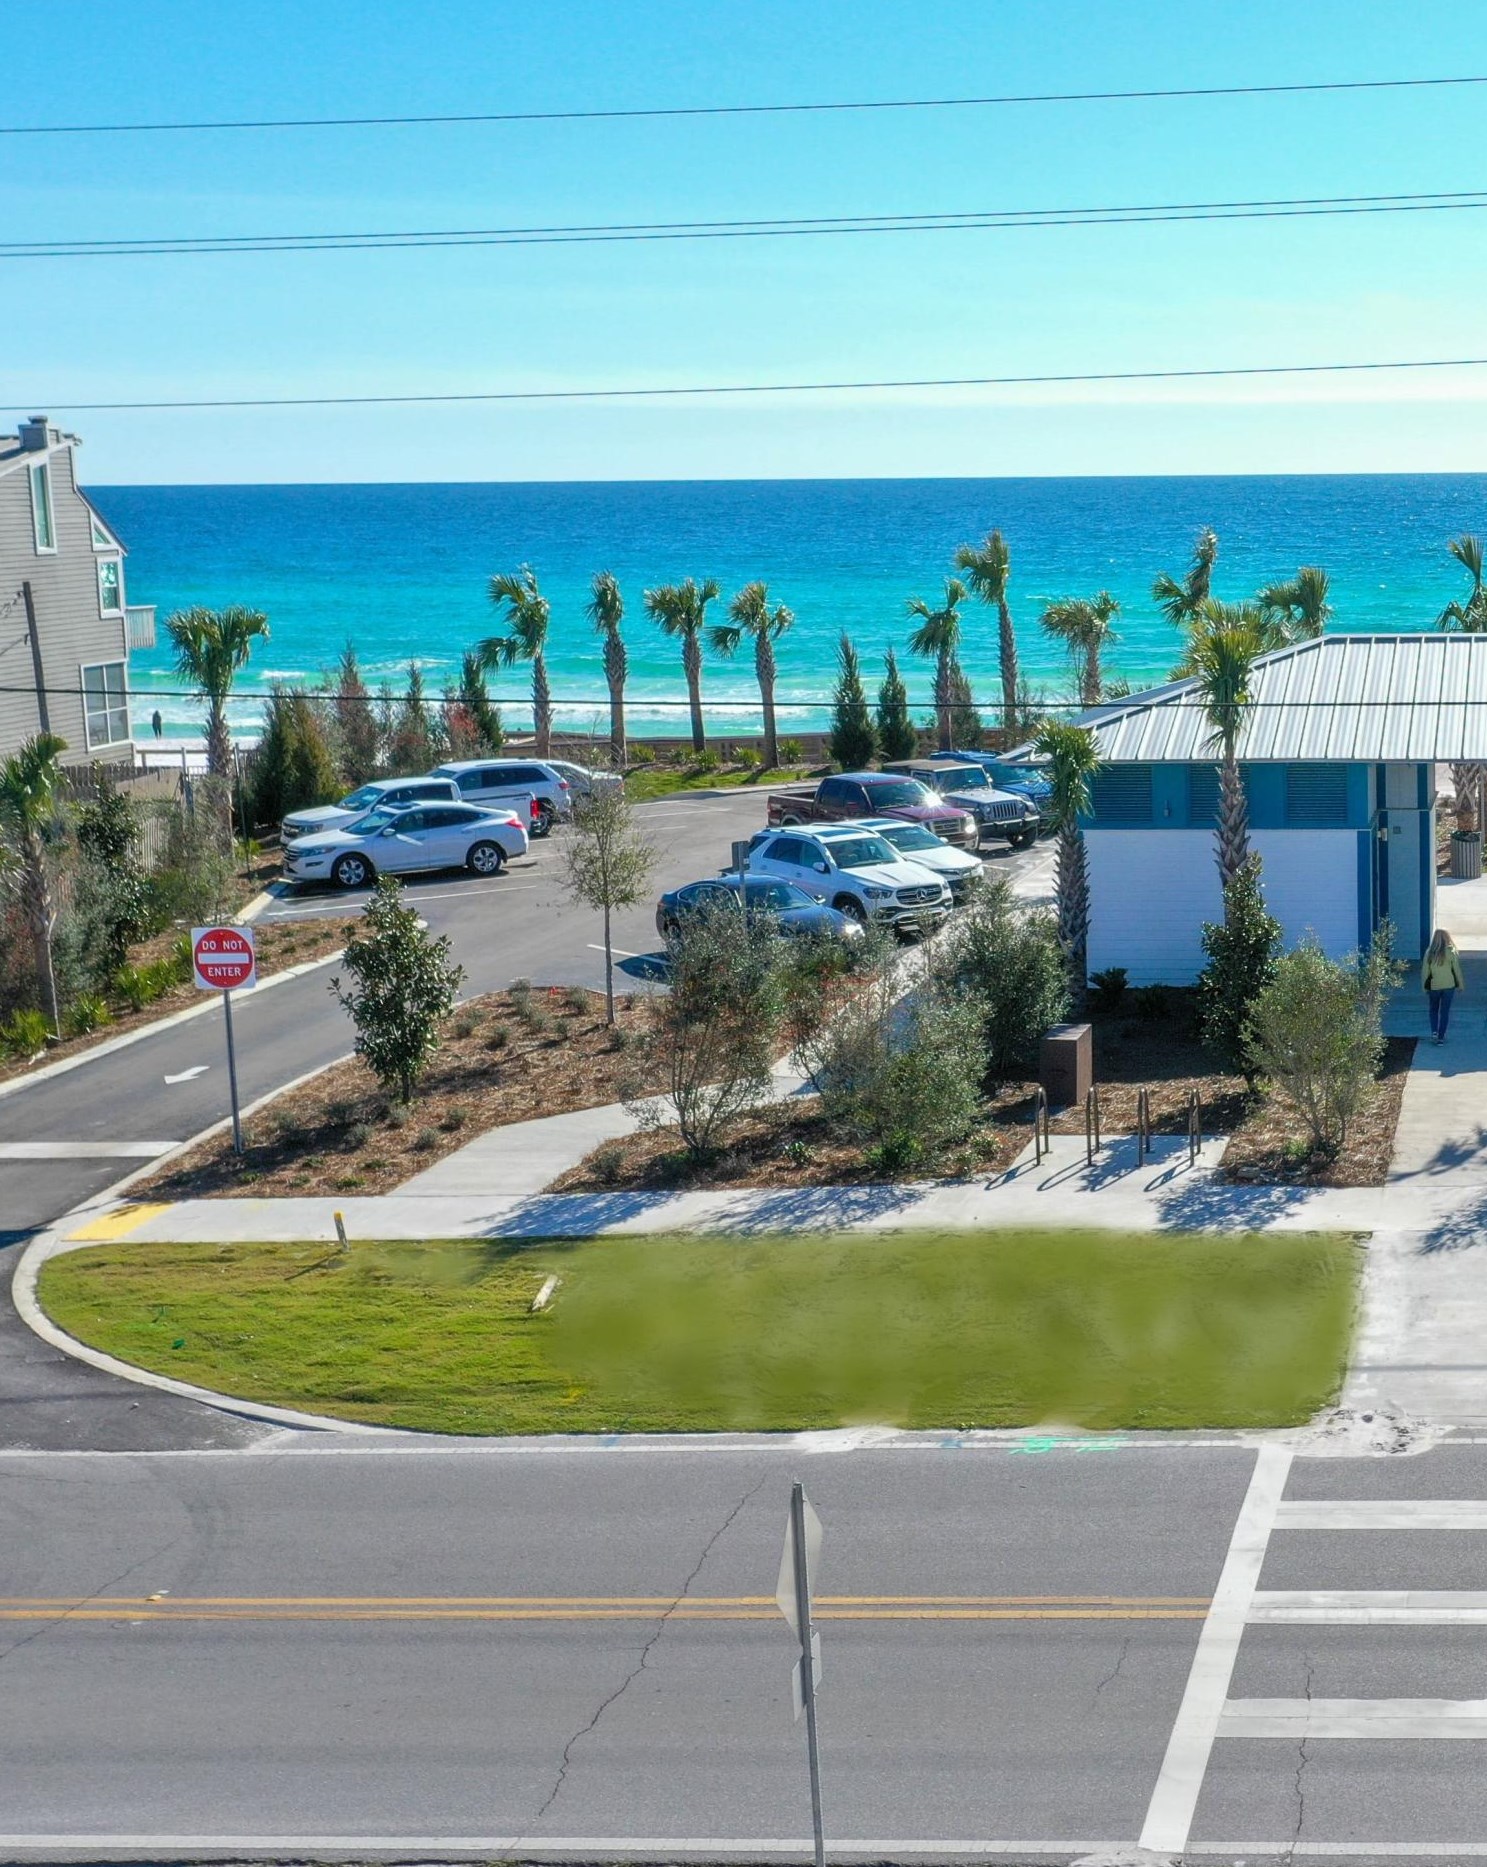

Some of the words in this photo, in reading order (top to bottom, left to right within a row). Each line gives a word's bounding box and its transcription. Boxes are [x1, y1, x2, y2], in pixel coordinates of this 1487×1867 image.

[202, 941, 216, 950] DO
[223, 940, 243, 950] NOT
[208, 967, 241, 977] ENTER
